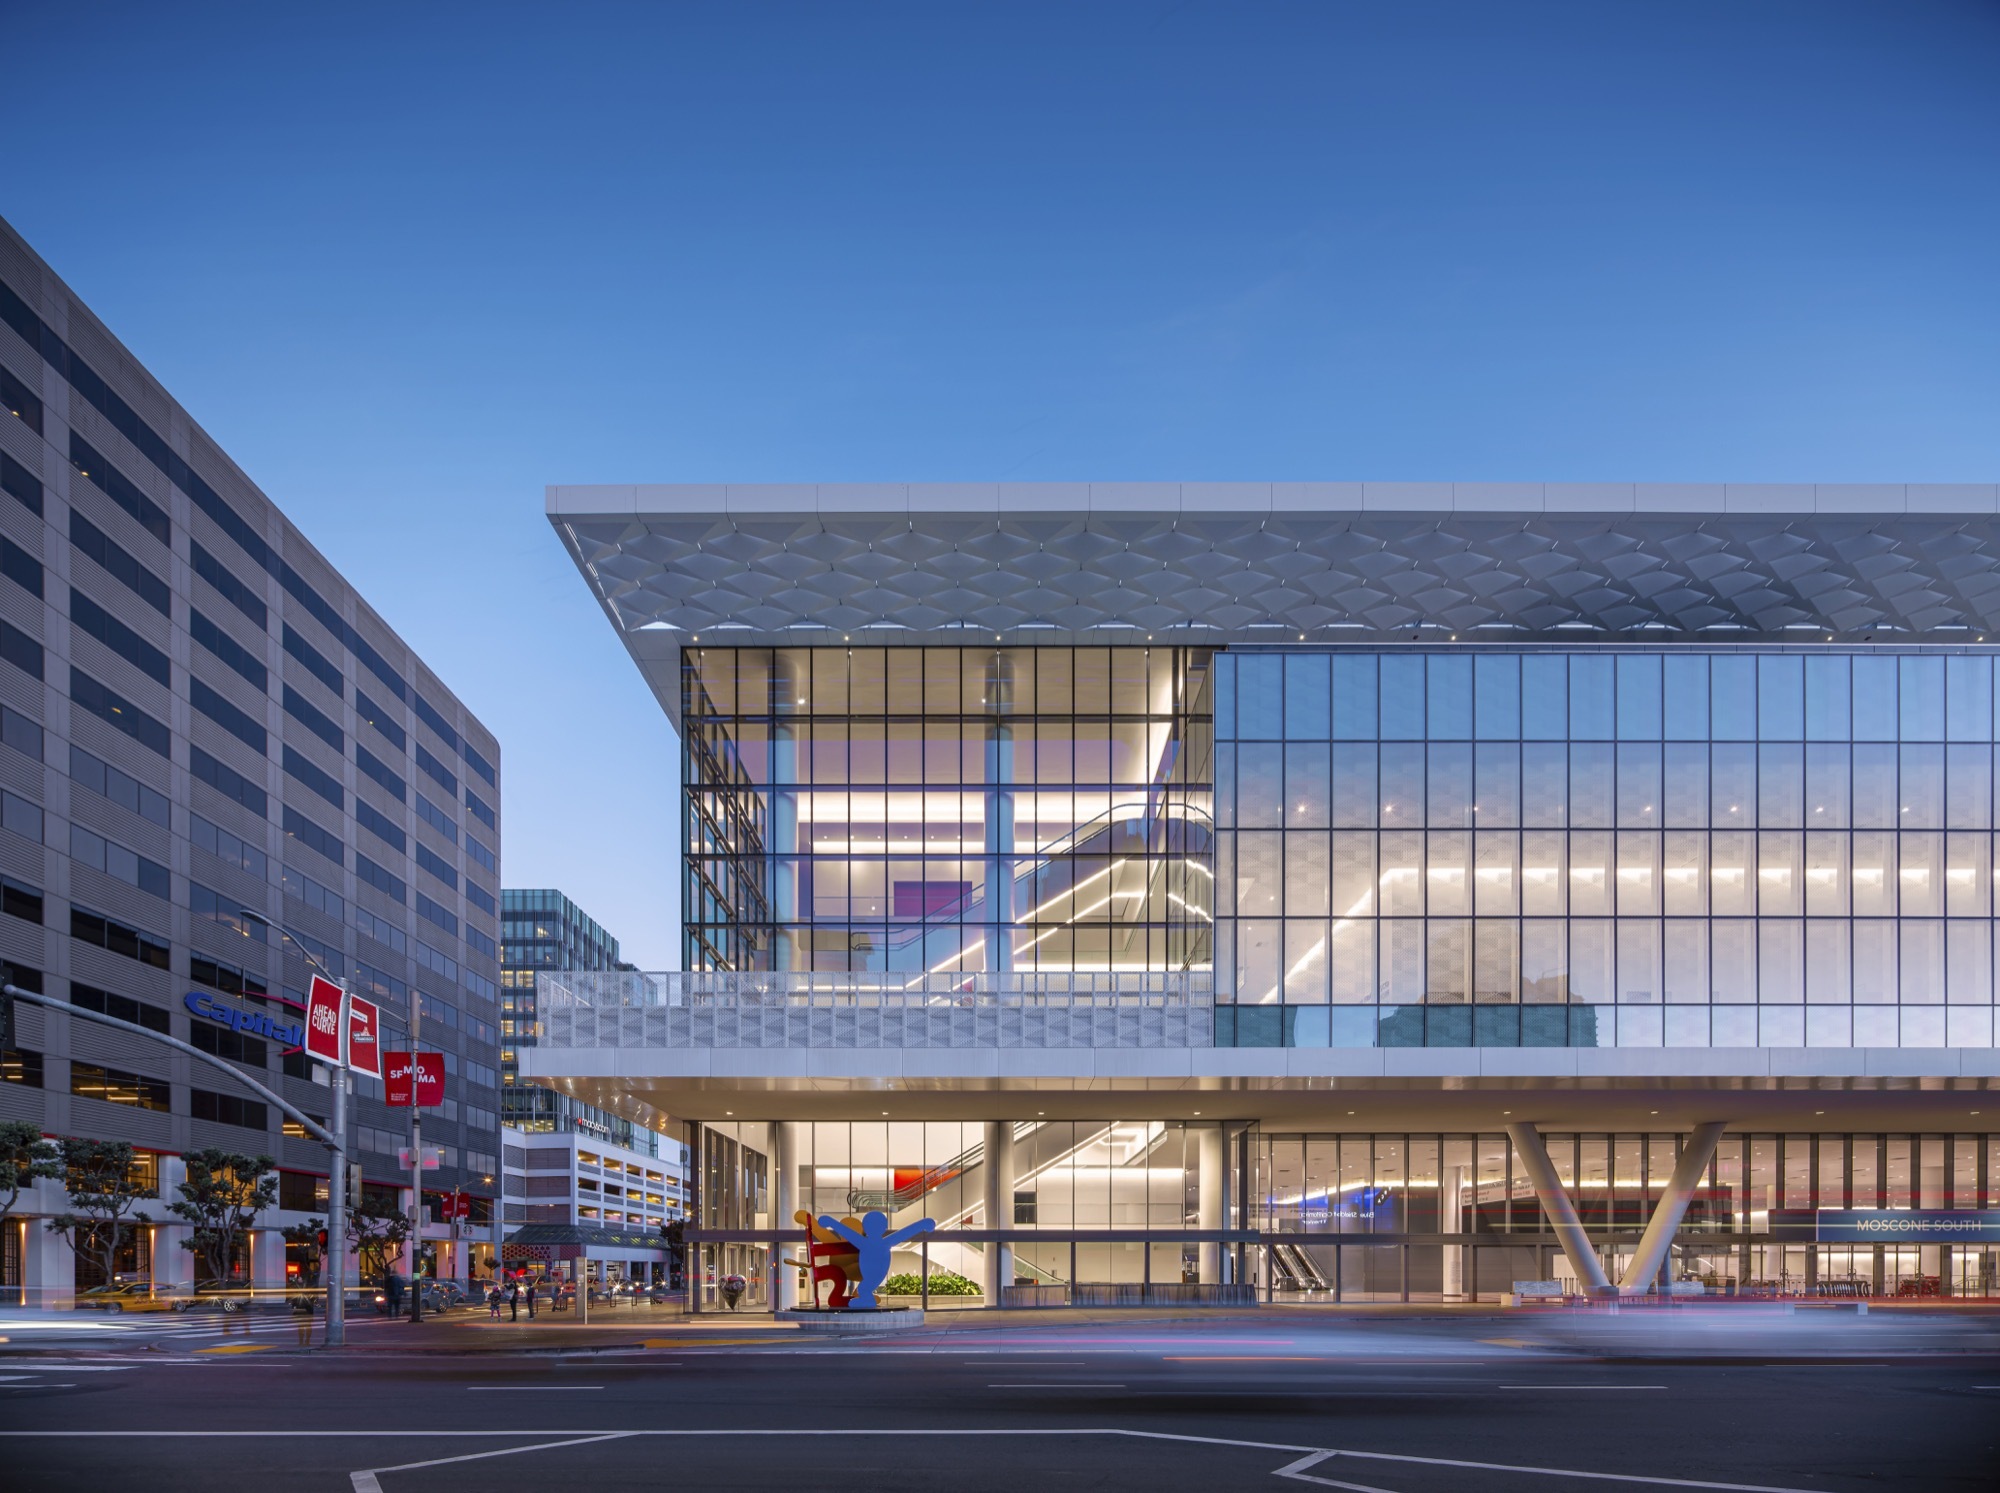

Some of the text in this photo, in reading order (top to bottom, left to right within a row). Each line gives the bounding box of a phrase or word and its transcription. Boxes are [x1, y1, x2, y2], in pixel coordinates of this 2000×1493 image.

[184, 992, 301, 1046] Capital
[313, 1004, 336, 1023] AHEAD
[311, 1014, 336, 1035] CURVE
[1857, 1219, 1981, 1231] MOSCONE SOUTH
